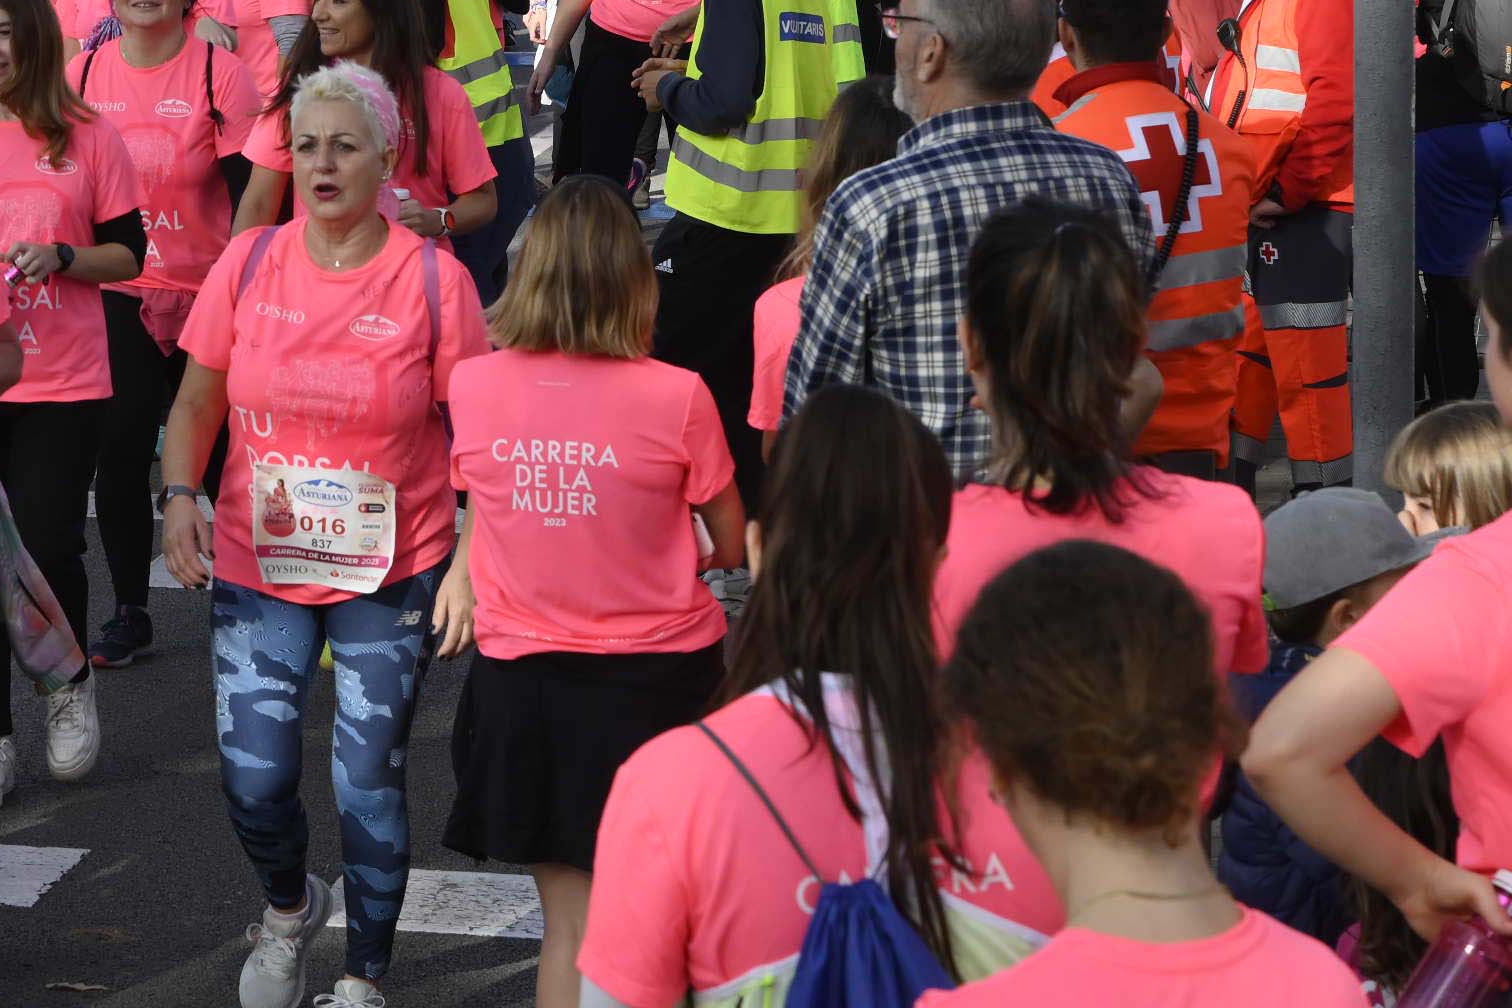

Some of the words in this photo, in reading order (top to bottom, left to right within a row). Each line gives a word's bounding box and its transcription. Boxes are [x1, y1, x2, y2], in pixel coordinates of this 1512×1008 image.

[235, 405, 273, 439] TU
[491, 438, 620, 468] CARRERA
[515, 464, 548, 488] DE
[558, 466, 592, 491] LA
[297, 488, 349, 503] ASTURIANA
[511, 491, 598, 515] MUJER
[299, 515, 347, 535] 016
[543, 517, 567, 527] 2023
[311, 537, 333, 550] 837
[270, 547, 306, 558] CARRERA
[307, 551, 318, 560] DE
[319, 552, 330, 561] LA
[331, 554, 359, 565] MUJER
[265, 563, 309, 575] OYSHO
